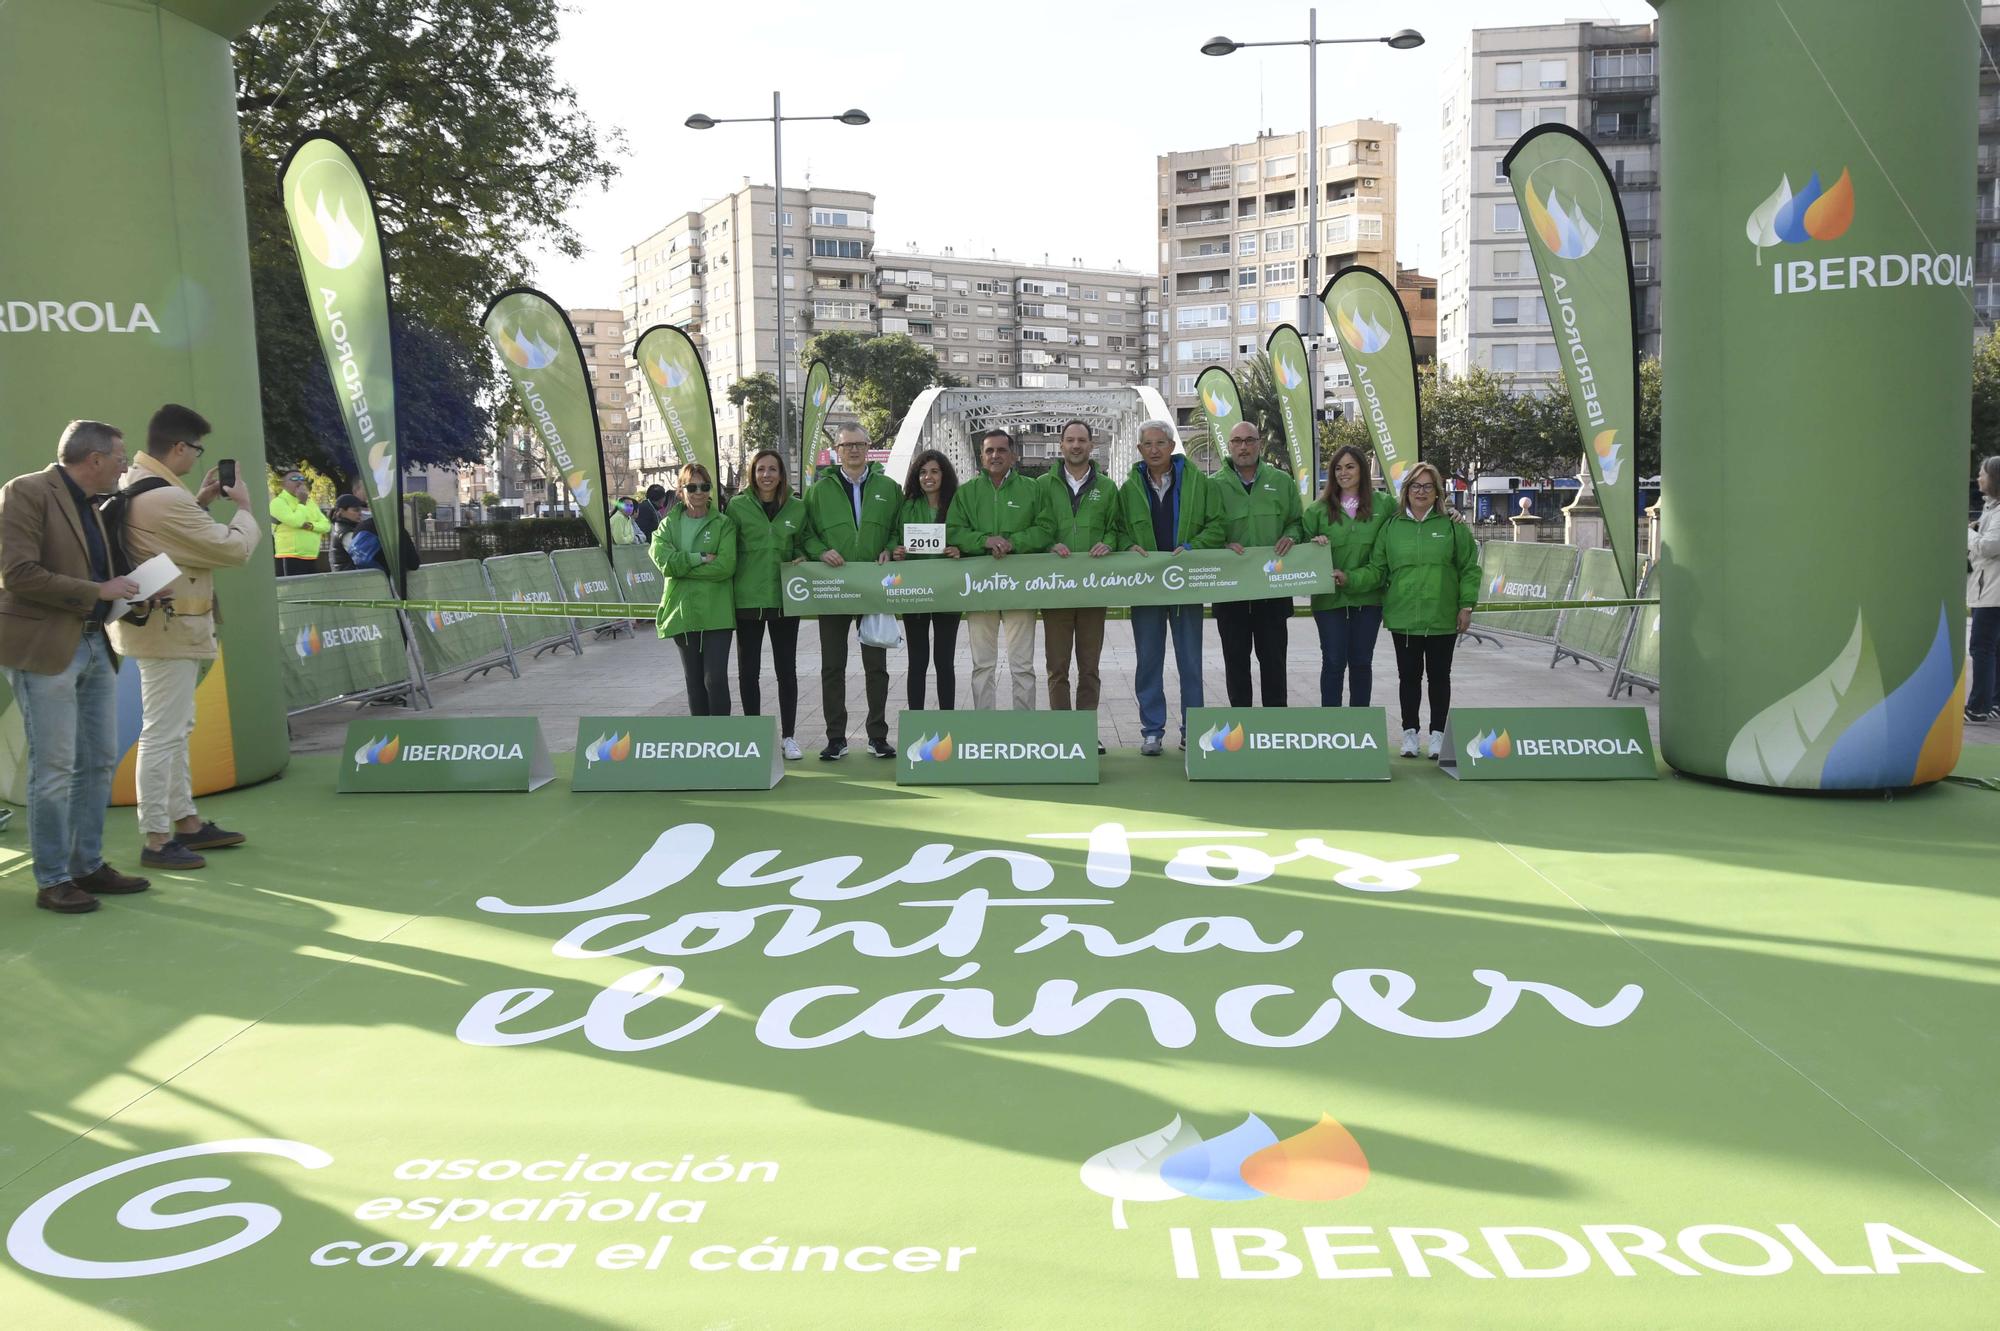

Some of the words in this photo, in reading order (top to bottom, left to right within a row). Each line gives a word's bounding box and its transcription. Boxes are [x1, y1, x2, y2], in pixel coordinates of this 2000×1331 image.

[1773, 253, 1974, 295] IBERDROLA
[910, 538, 940, 548] 2010
[959, 572, 1020, 597] Juntos
[1025, 572, 1078, 591] contra
[1083, 572, 1099, 588] el
[1100, 571, 1155, 588] cáncer
[1269, 570, 1317, 582] IBERDROLA
[886, 587, 934, 597] IBERDROLA
[401, 743, 524, 762] IBERDROLA
[635, 741, 761, 759] IBERDROLA
[957, 742, 1086, 760] IBERDROLA
[1248, 733, 1378, 751] IBERDROLA
[1516, 738, 1643, 756] IBERDROLA
[476, 822, 1461, 914] Juntos
[551, 887, 1304, 961] contra
[456, 965, 724, 1051] el
[754, 962, 1644, 1050] cáncer
[393, 1153, 780, 1183] asociación
[354, 1191, 706, 1230] española
[310, 1235, 577, 1269] contra
[595, 1235, 673, 1271] el
[688, 1237, 977, 1273] cáncer
[1168, 1223, 1984, 1281] IBERDROLA
